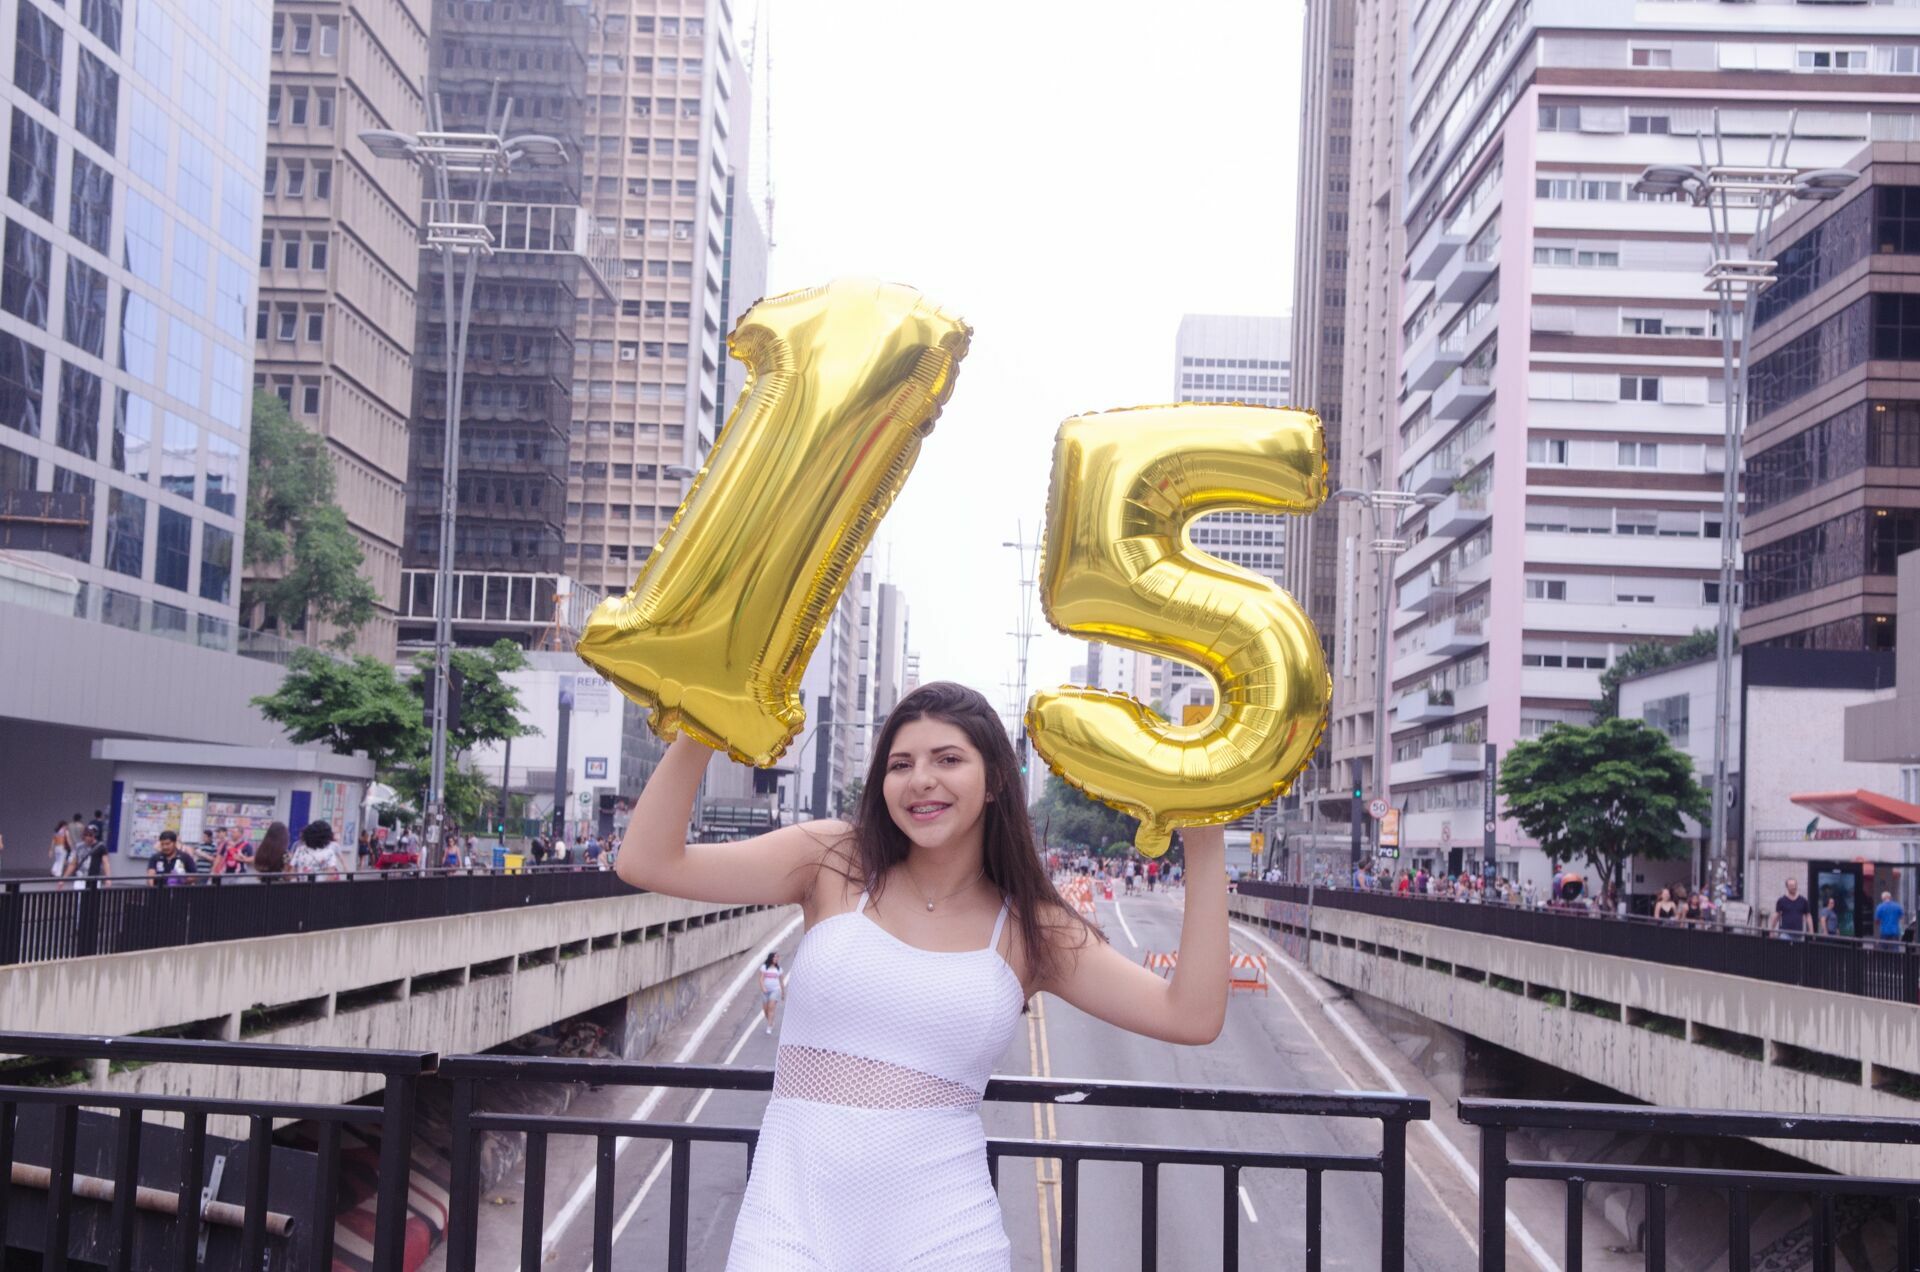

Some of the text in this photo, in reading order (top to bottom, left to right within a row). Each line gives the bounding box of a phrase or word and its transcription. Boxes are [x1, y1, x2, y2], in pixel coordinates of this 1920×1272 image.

[576, 277, 1333, 842] 1 5
[1372, 802, 1386, 812] 50
